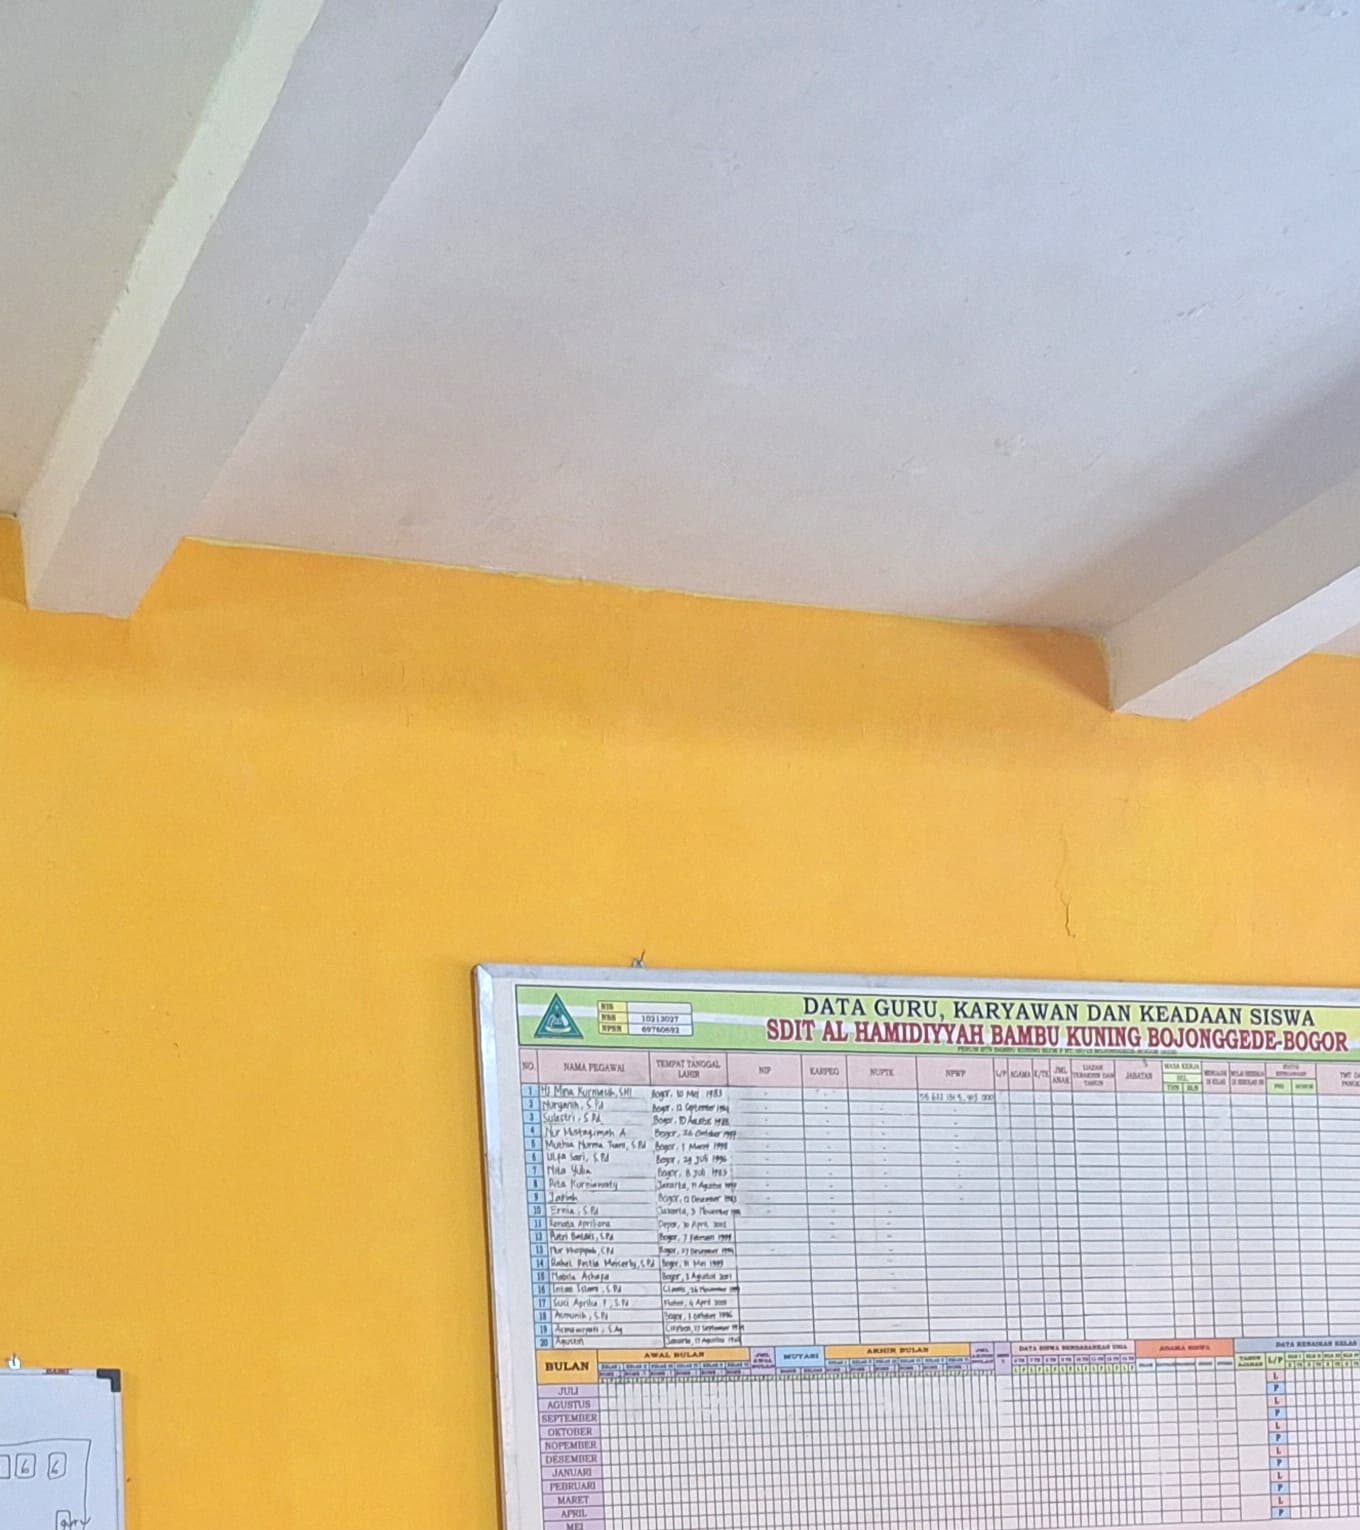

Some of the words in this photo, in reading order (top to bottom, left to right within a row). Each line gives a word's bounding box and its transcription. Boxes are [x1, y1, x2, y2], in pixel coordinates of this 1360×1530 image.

[803, 997, 867, 1017] DATA
[874, 999, 946, 1021] GURU,
[953, 1000, 1079, 1021] KARYAWAN
[1087, 1004, 1131, 1022] DAN
[1140, 1005, 1242, 1025] KEADAAN
[1250, 1008, 1316, 1027] SISWA
[766, 1018, 815, 1041] SDIT
[822, 1020, 849, 1042] AL
[854, 1020, 985, 1045] HAMIDIYYAH
[991, 1024, 1060, 1047] BAMBU
[1066, 1026, 1141, 1048] KUNING
[1147, 1027, 1349, 1051] BOJONGGEDE-BOGOR
[545, 1362, 589, 1372] BULAN
[557, 1387, 579, 1396] JULI
[547, 1399, 591, 1409] AGUSTUS
[541, 1413, 597, 1423] SEPTEMBER
[547, 1426, 592, 1436] OKTOBER
[545, 1440, 597, 1450] NOPEMBER
[545, 1454, 598, 1464] DESEMBER
[20, 1458, 30, 1474] 6
[552, 1468, 592, 1477] JANUARI
[557, 1495, 590, 1505] MARET
[560, 1509, 588, 1518] APRIL
[566, 1523, 584, 1530] MEI
